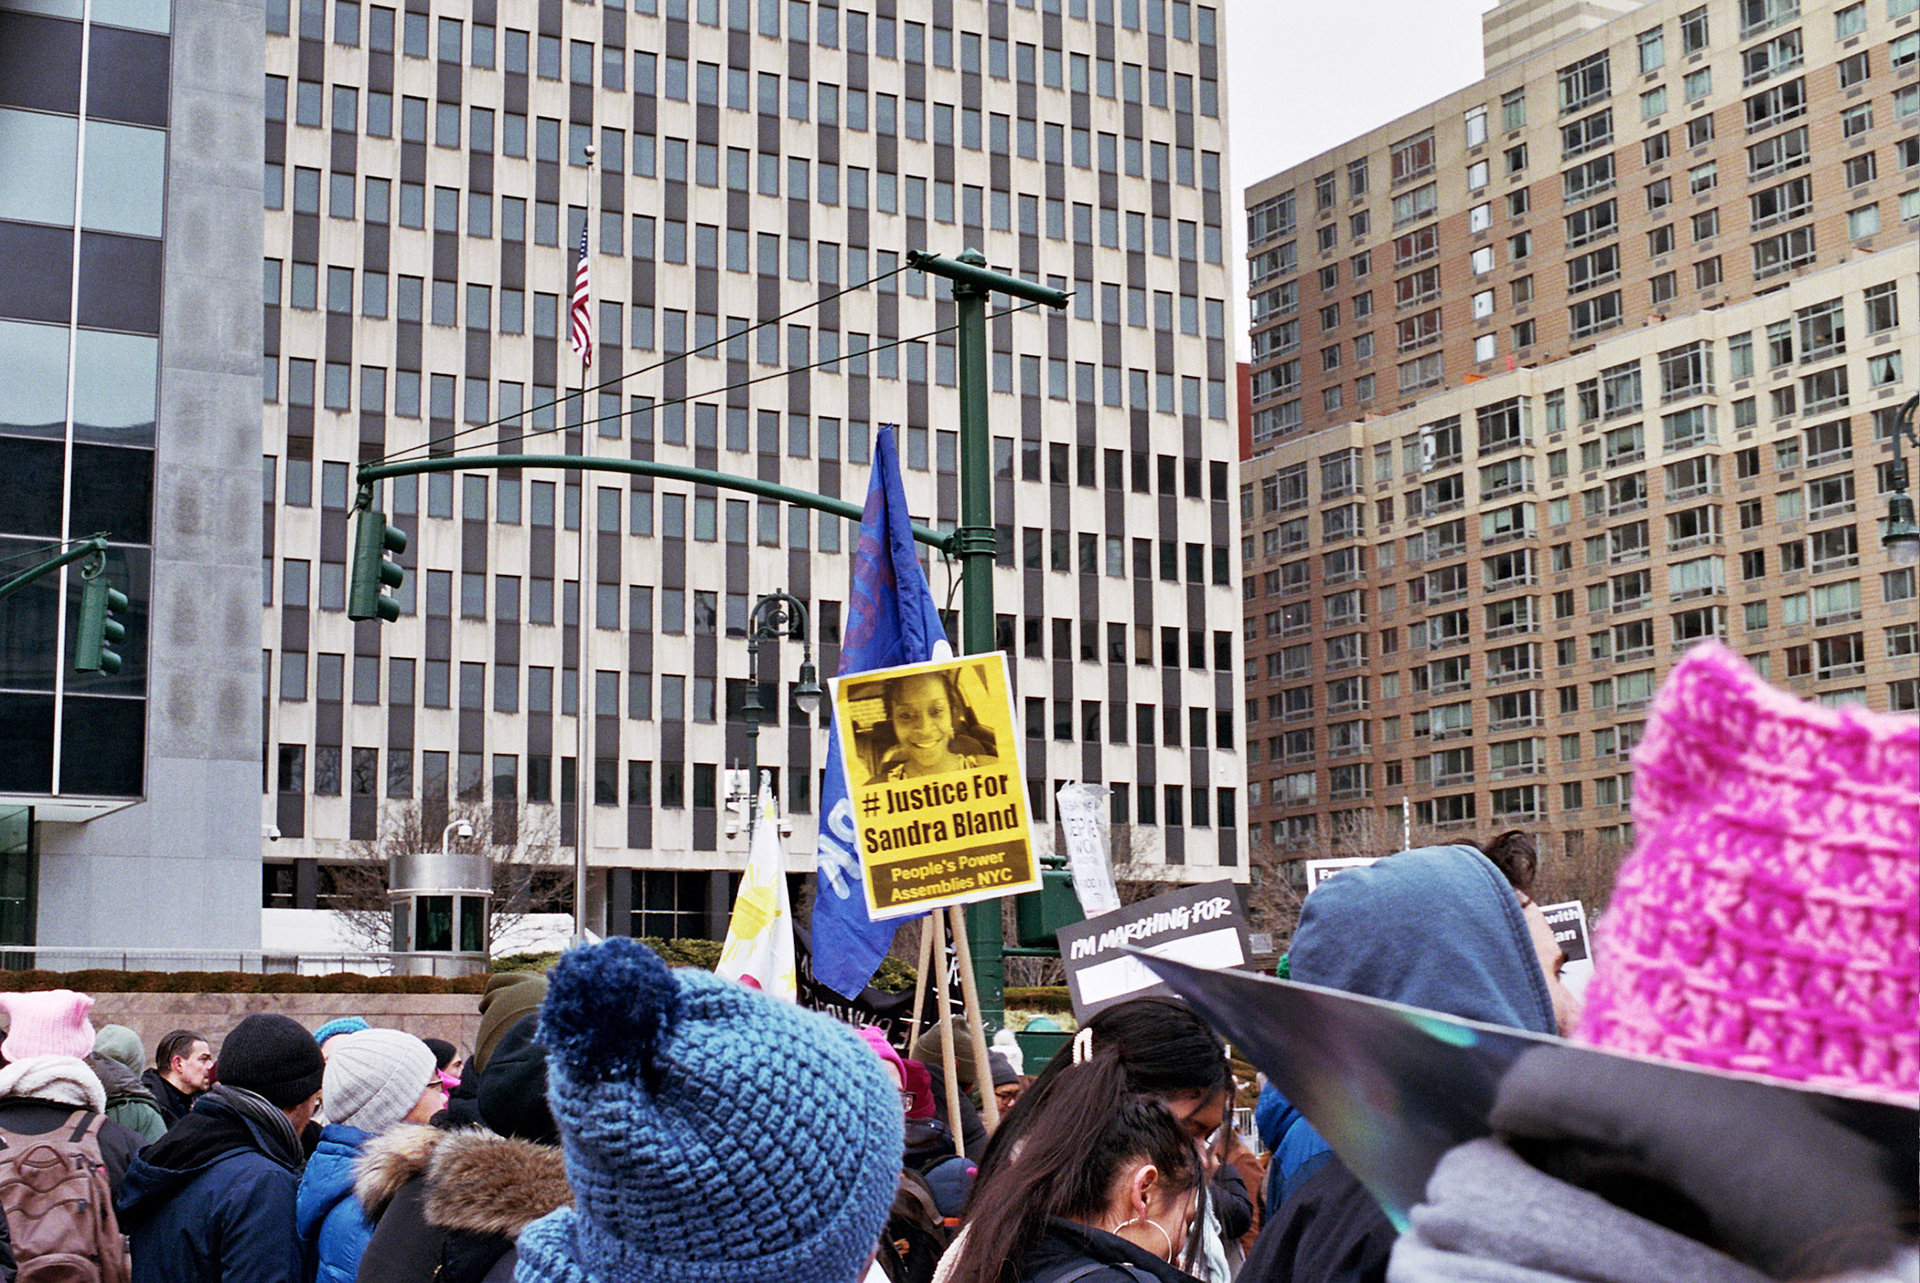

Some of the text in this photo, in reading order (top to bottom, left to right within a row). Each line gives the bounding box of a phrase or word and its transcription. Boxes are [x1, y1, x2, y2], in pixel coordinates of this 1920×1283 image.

[887, 780, 968, 815] Justice
[974, 773, 1009, 798] For
[864, 803, 1019, 855] Sandra Bland
[890, 867, 1013, 903] Assemblies NYC
[891, 850, 1006, 882] People's Power
[1070, 897, 1232, 960] I'M MARCHING FOR
